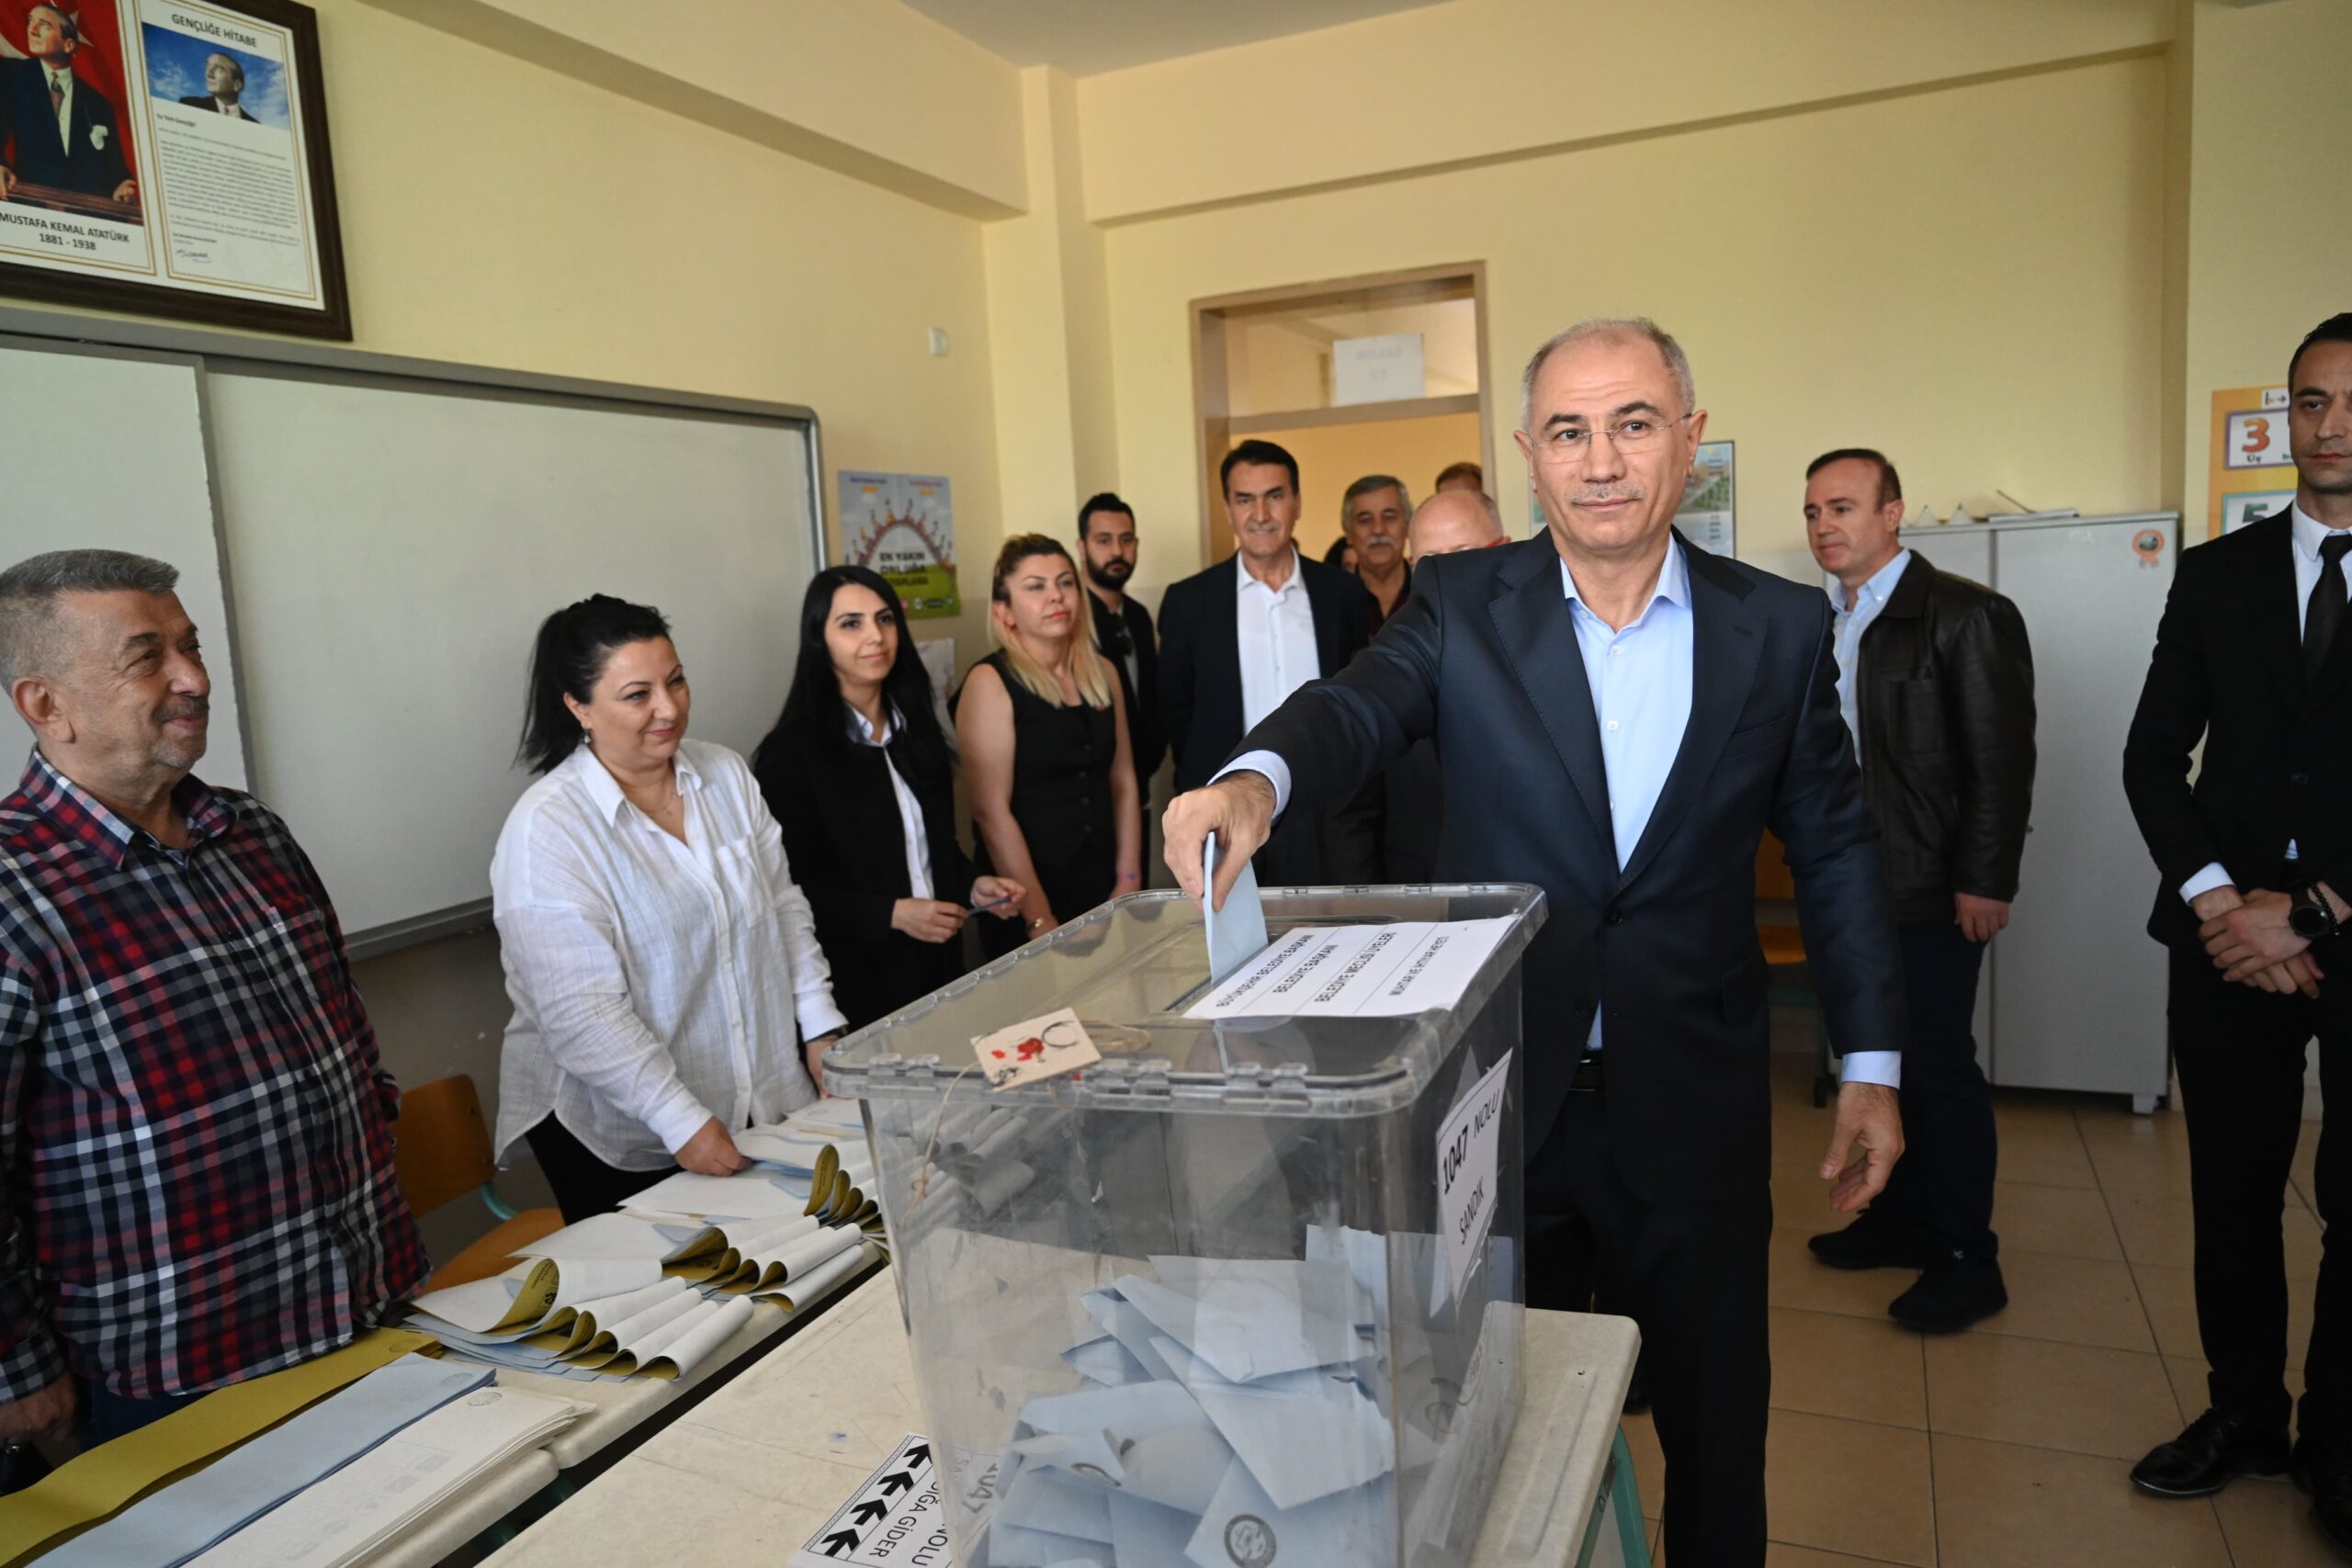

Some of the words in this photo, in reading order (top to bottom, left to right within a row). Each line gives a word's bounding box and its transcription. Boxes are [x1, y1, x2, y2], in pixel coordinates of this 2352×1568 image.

[171, 13, 221, 37] GENÇLİĞE
[222, 28, 257, 49] HİTABE
[0, 212, 49, 230] MUSTAFA
[50, 221, 85, 236] KEMAL
[87, 228, 130, 243] ATATÜRK
[39, 232, 63, 245] 1881
[73, 238, 96, 251] 1938
[2242, 419, 2270, 453] 3
[1253, 953, 1293, 976] BELEDİYE
[1280, 934, 1315, 953] BAŞKANI
[1270, 966, 1314, 993] BELEDİYE
[1301, 944, 1339, 966] BAŞKANI
[1312, 973, 1355, 1002] BELEDİYE
[1341, 953, 1376, 974] MECLİSİ
[1361, 931, 1397, 952] ÜYELERİ
[1387, 975, 1416, 996] MUHTAR
[1427, 935, 1450, 951] HEYETİ
[1443, 1123, 1468, 1195] 1047
[1474, 1088, 1500, 1138] NOLU
[1459, 1176, 1484, 1246] SANDIK
[869, 1516, 917, 1558] GİDER
